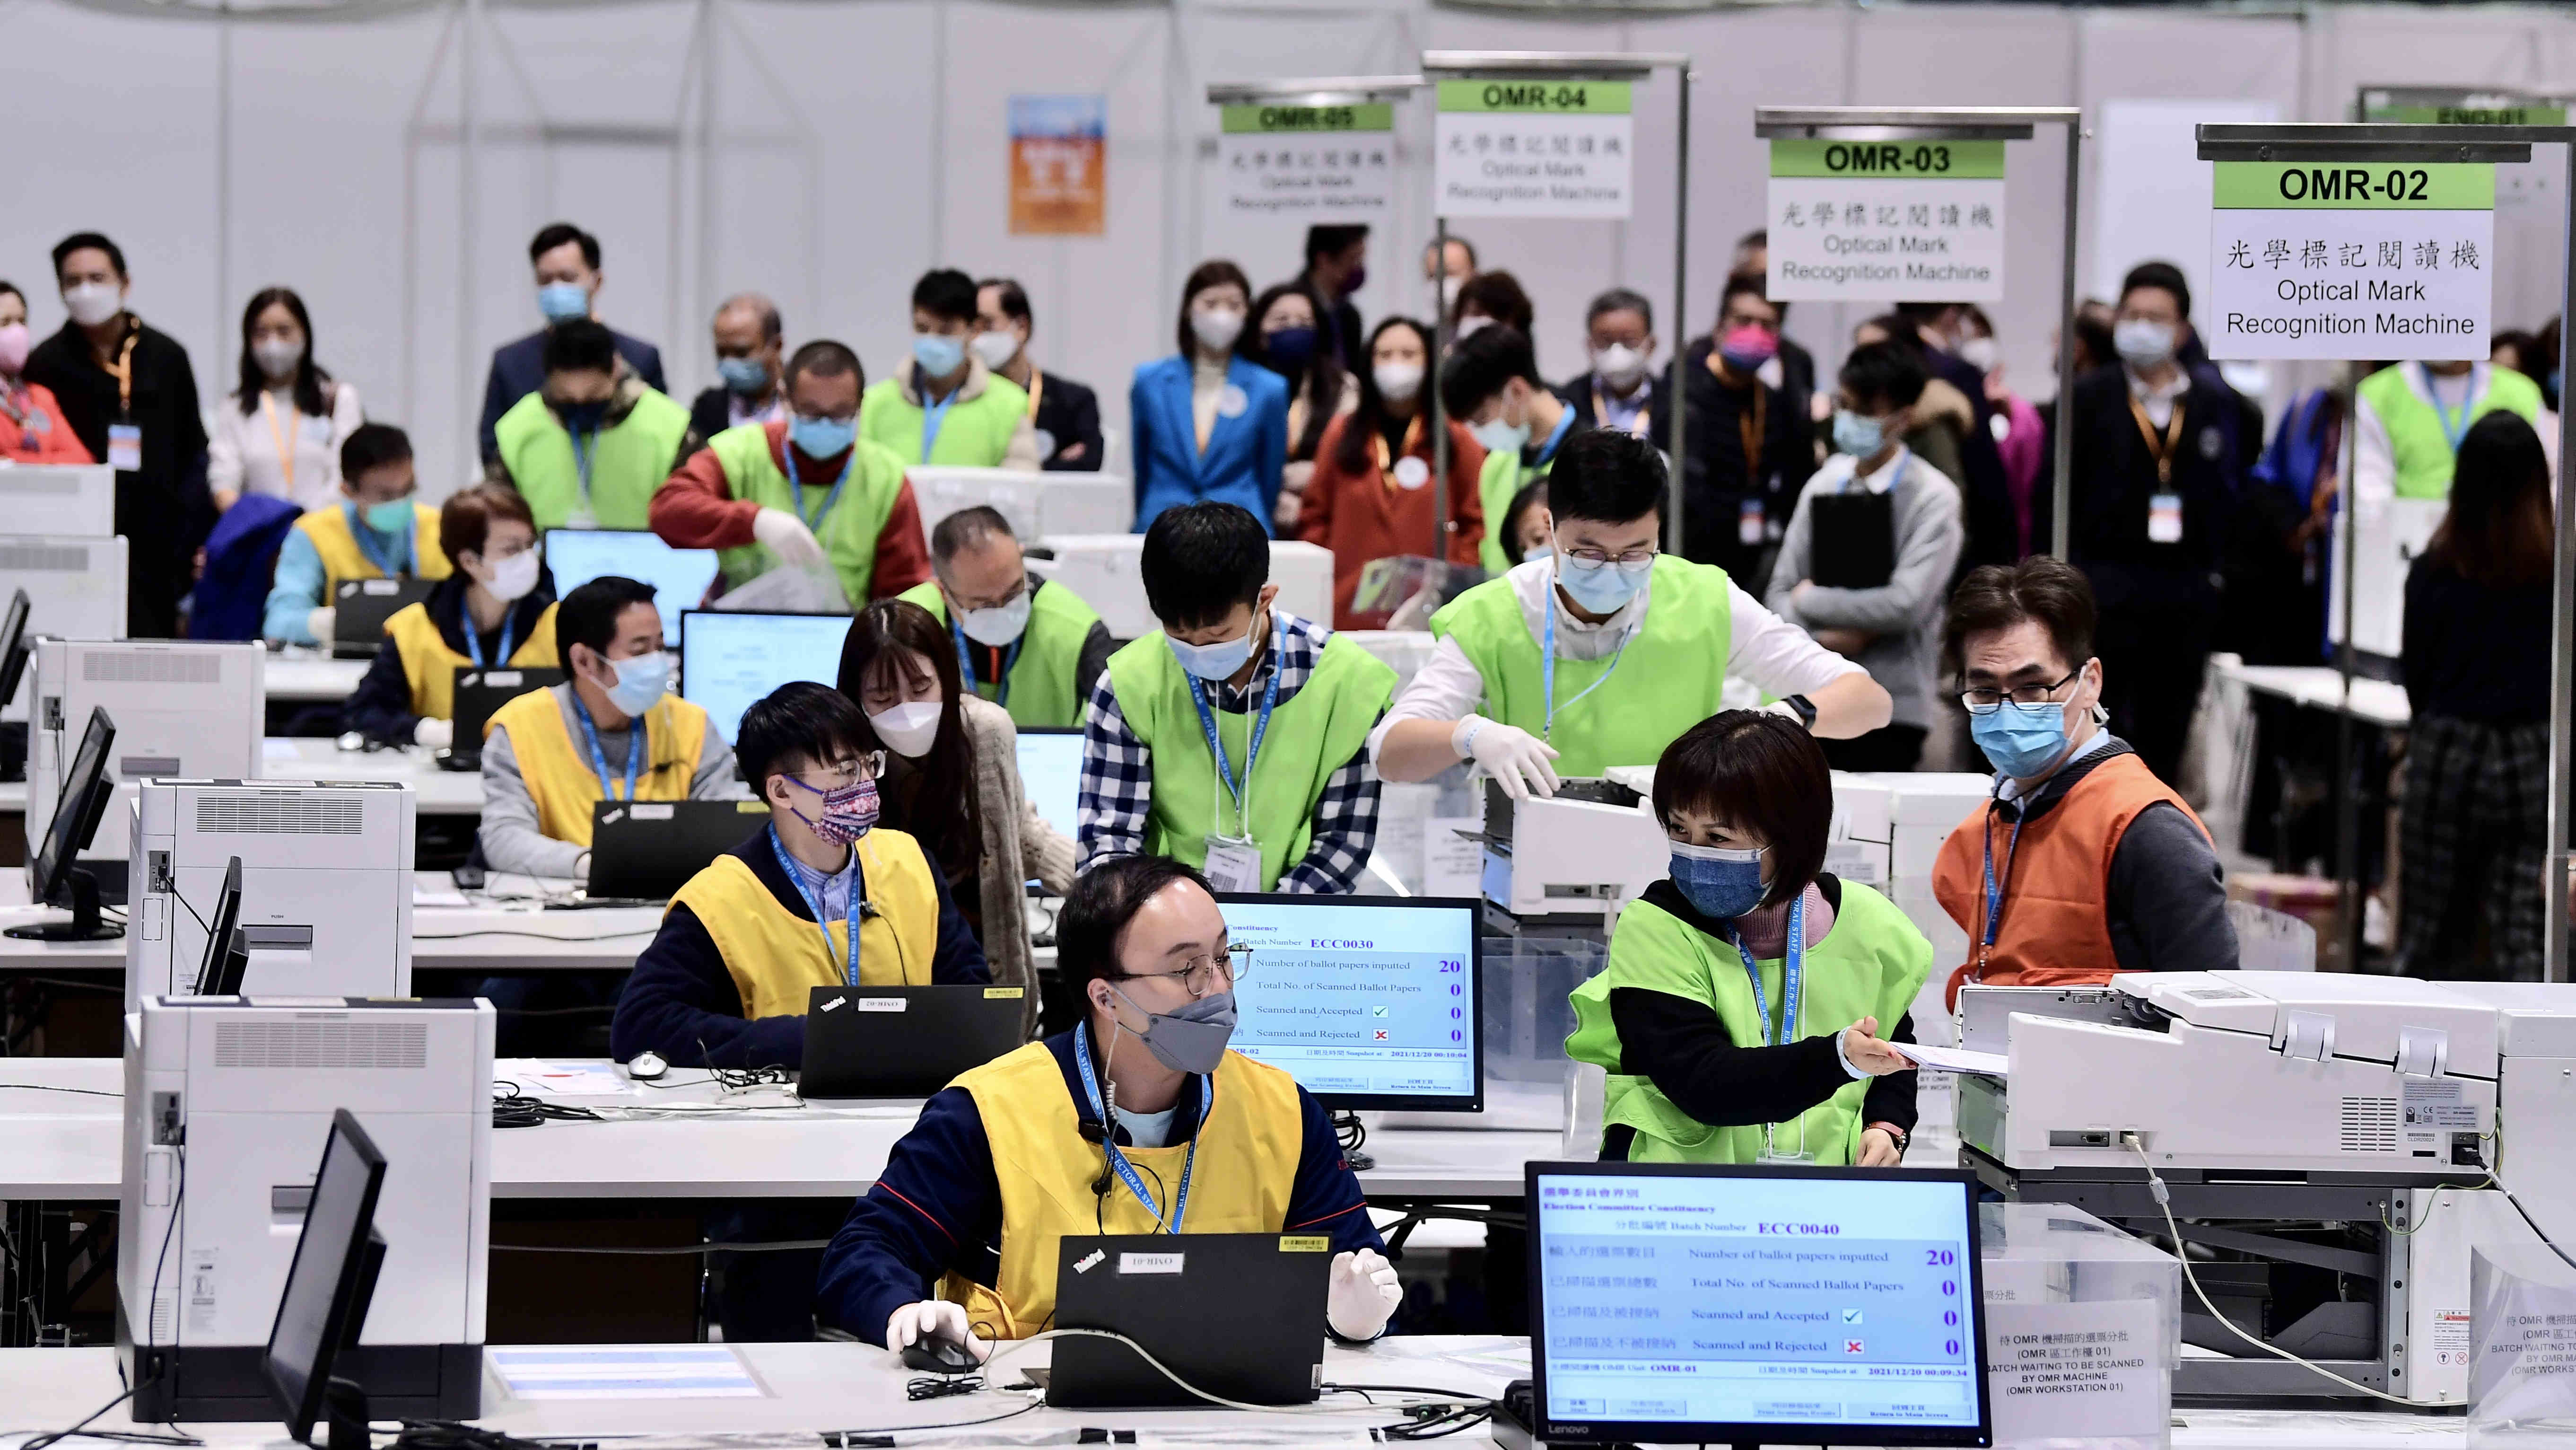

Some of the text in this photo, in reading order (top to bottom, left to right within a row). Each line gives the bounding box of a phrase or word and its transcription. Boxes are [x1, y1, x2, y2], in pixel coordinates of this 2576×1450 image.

[1483, 85, 1587, 109] OMR-04
[1260, 106, 1356, 130] OMR-05
[1825, 145, 1950, 172] OMR-03
[1482, 160, 1585, 178] Optical Mark
[1447, 183, 1620, 202] Recognition Machine
[2279, 169, 2428, 201] OMR-02
[1824, 236, 1948, 257] Optical Mark
[2226, 239, 2480, 271] 光學標記閱讀機
[1782, 262, 1990, 284] Recognition Machine
[2278, 280, 2426, 305] Optical Mark
[2227, 313, 2474, 339] Recognition Machine
[1310, 939, 1373, 949] ECC0030
[1256, 959, 1460, 973] Number of ballot papers inputted 20
[1256, 981, 1281, 989] Total
[1316, 983, 1356, 991] Scanned
[1359, 984, 1387, 992] Ballot
[1390, 984, 1422, 993] Papers
[1450, 984, 1461, 996] 0
[1256, 1006, 1461, 1019] Scanned and Accepted 0
[1256, 1029, 1461, 1042] Scanned and Rejected 0
[1081, 1056, 1092, 1081] STAFF
[1112, 1150, 1142, 1195] ECTORAL
[1178, 1155, 1192, 1207] ELECTORAL
[1648, 1204, 1716, 1214] Constituency
[1670, 1222, 1839, 1235] Batch Number ECC0040
[1688, 1249, 1954, 1266] Number of ballot papers inputted 20
[1691, 1278, 1722, 1288] Total
[1751, 1278, 1766, 1288] of
[1768, 1279, 1820, 1289] Scanned
[1824, 1279, 1860, 1290] Ballot
[1863, 1281, 1904, 1292] Papers
[1942, 1280, 1956, 1296] 0
[1691, 1309, 1957, 1326] Scanned and Accepted 0
[2519, 1316, 2542, 1325] OMR
[2013, 1335, 2039, 1345] OMR
[2523, 1329, 2550, 1340] (OMR
[1693, 1338, 1959, 1355] Scanned and Rejected 0
[2096, 1346, 2111, 1357] 01)
[2491, 1343, 2565, 1353] BATCH WAITING
[2017, 1349, 2047, 1360] (OMR
[2526, 1354, 2563, 1363] BY OMR
[1650, 1364, 1697, 1372] OMR-01
[1810, 1367, 1847, 1376] Snapshot
[1868, 1367, 1922, 1376] 2021/12/20
[1924, 1368, 1967, 1377] 00:09:34
[2020, 1362, 2062, 1371] WAITING
[2065, 1362, 2078, 1370] TO
[2081, 1361, 2094, 1370] BE
[2096, 1358, 2144, 1369] SCANNED
[2512, 1365, 2536, 1377] (OMR
[2022, 1371, 2108, 1383] BY OMR MACHINE
[2007, 1382, 2123, 1397] (OMR WORKSTATION 01)
[1548, 1424, 1589, 1434] Lenovo
